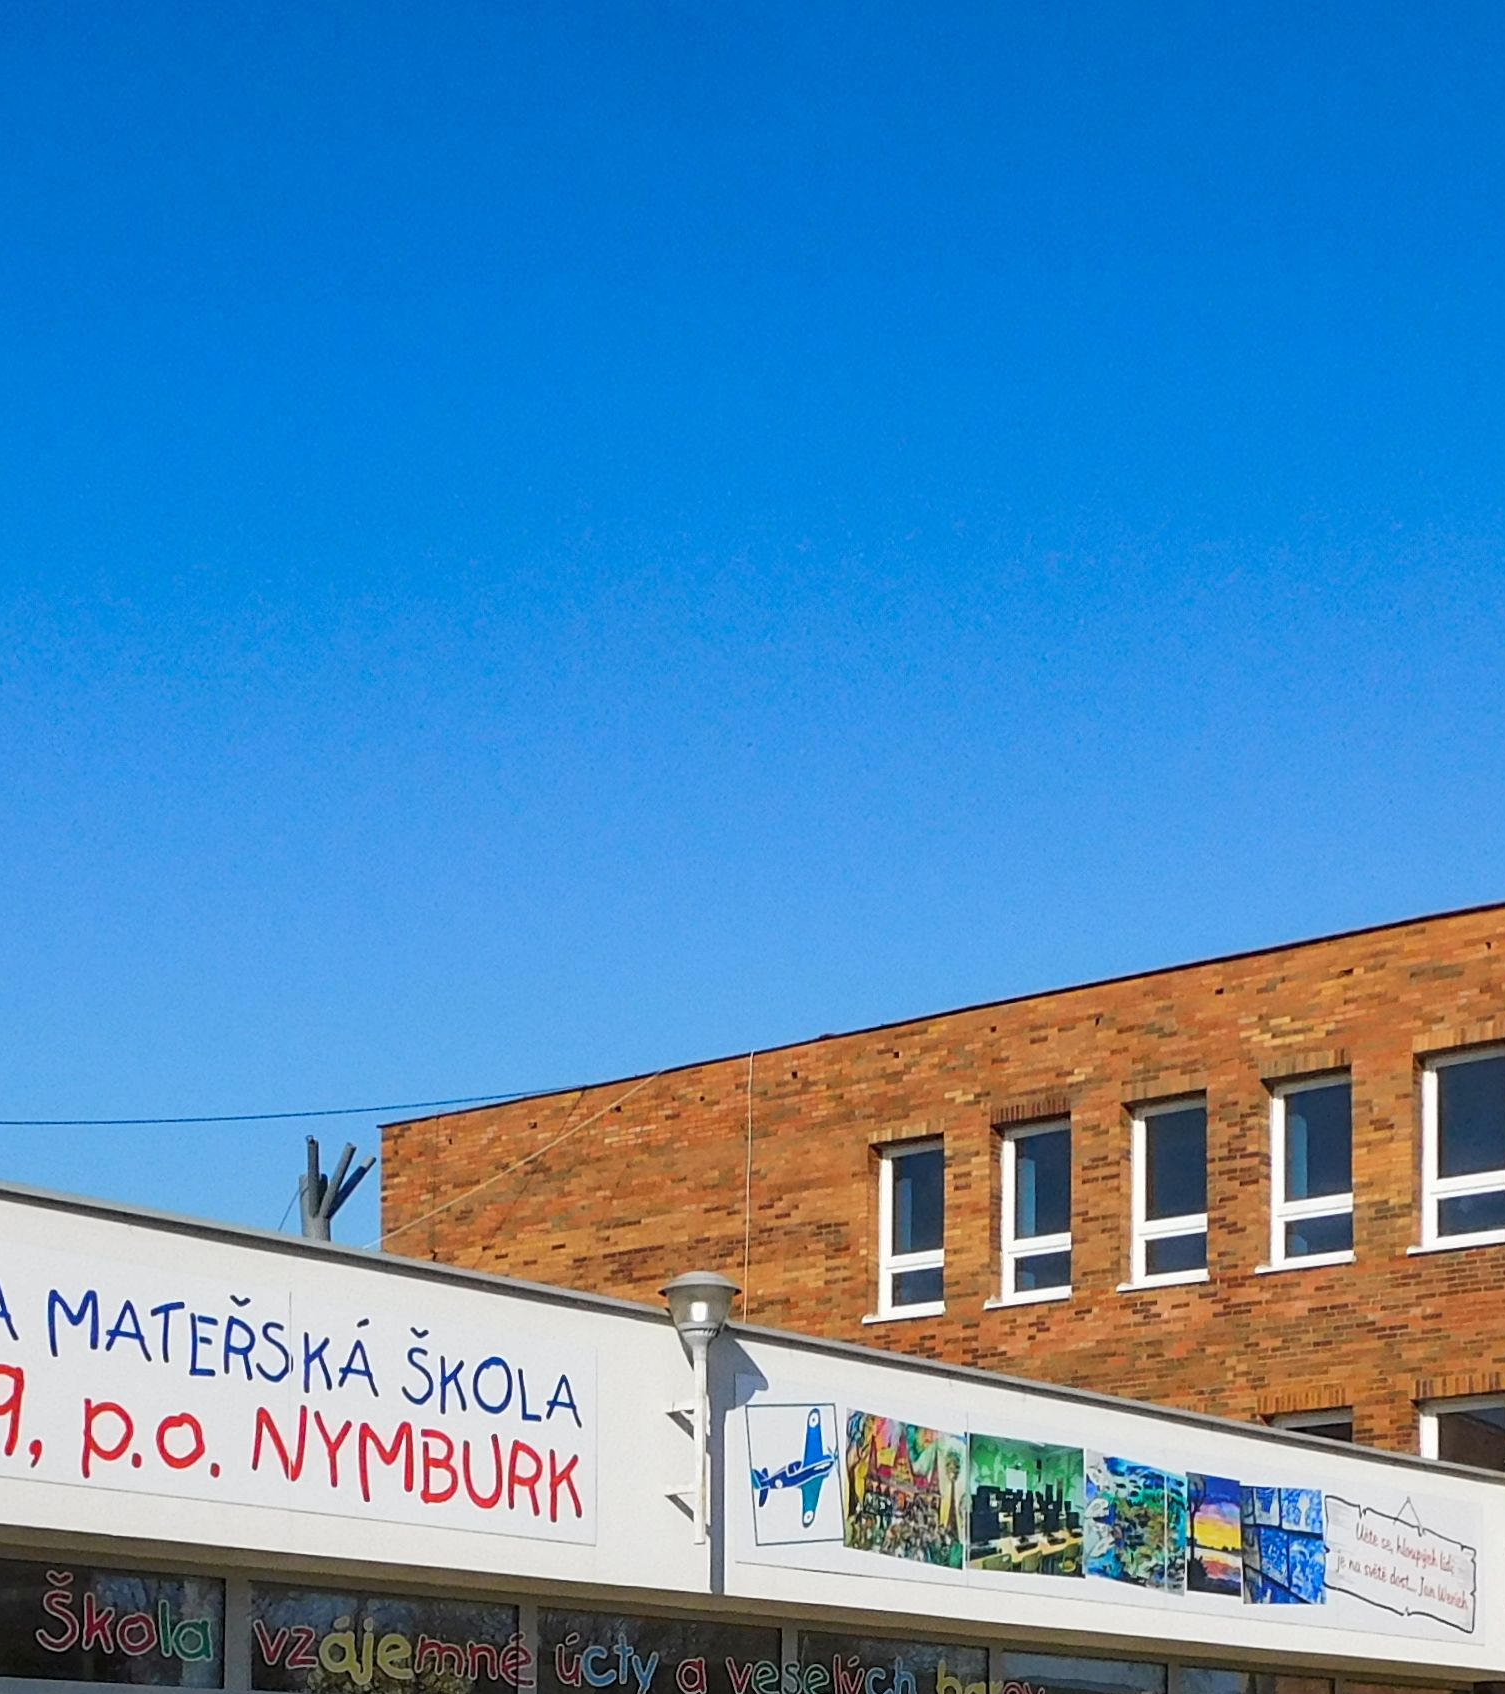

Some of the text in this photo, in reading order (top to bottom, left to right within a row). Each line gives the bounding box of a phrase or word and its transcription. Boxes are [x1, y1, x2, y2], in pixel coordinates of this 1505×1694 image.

[47, 1288, 377, 1396] MATEŘSKÁ
[405, 1328, 583, 1429] ŠKOLA
[81, 1399, 222, 1479] p.o.
[252, 1406, 584, 1522] NYMBURK
[1349, 1560, 1361, 1573] na
[36, 1570, 215, 1663] Škola
[253, 1616, 537, 1687] vzájemné
